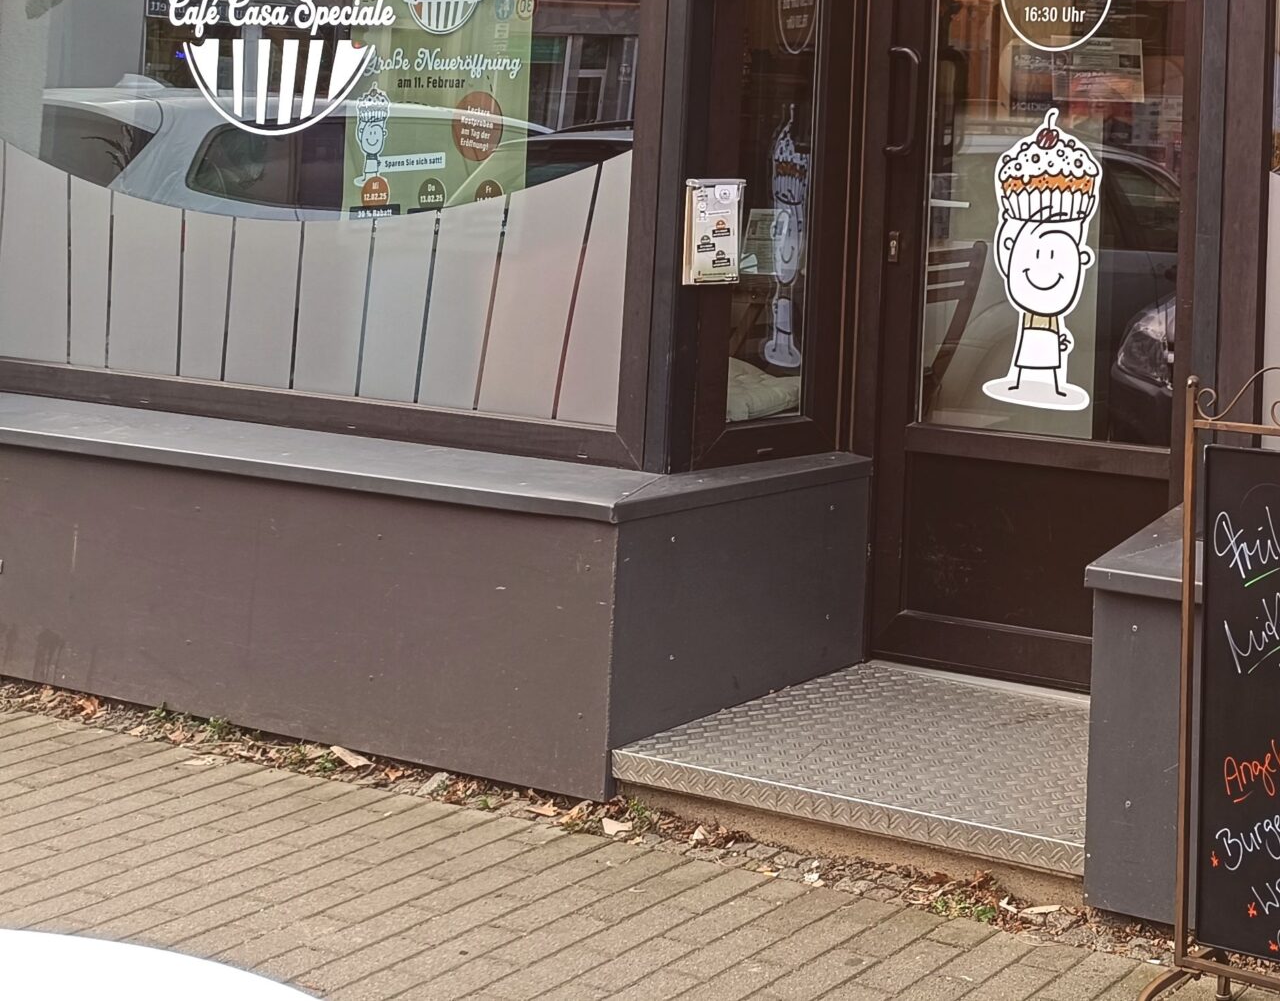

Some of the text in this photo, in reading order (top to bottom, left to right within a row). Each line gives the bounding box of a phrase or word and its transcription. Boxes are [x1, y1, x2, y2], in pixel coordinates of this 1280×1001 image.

[1024, 6, 1086, 23] 16:30 Uhr
[414, 48, 522, 80] Neueröffnung
[397, 77, 466, 89] am 11. Februar
[384, 160, 405, 169] Sparen
[415, 158, 429, 166] sich
